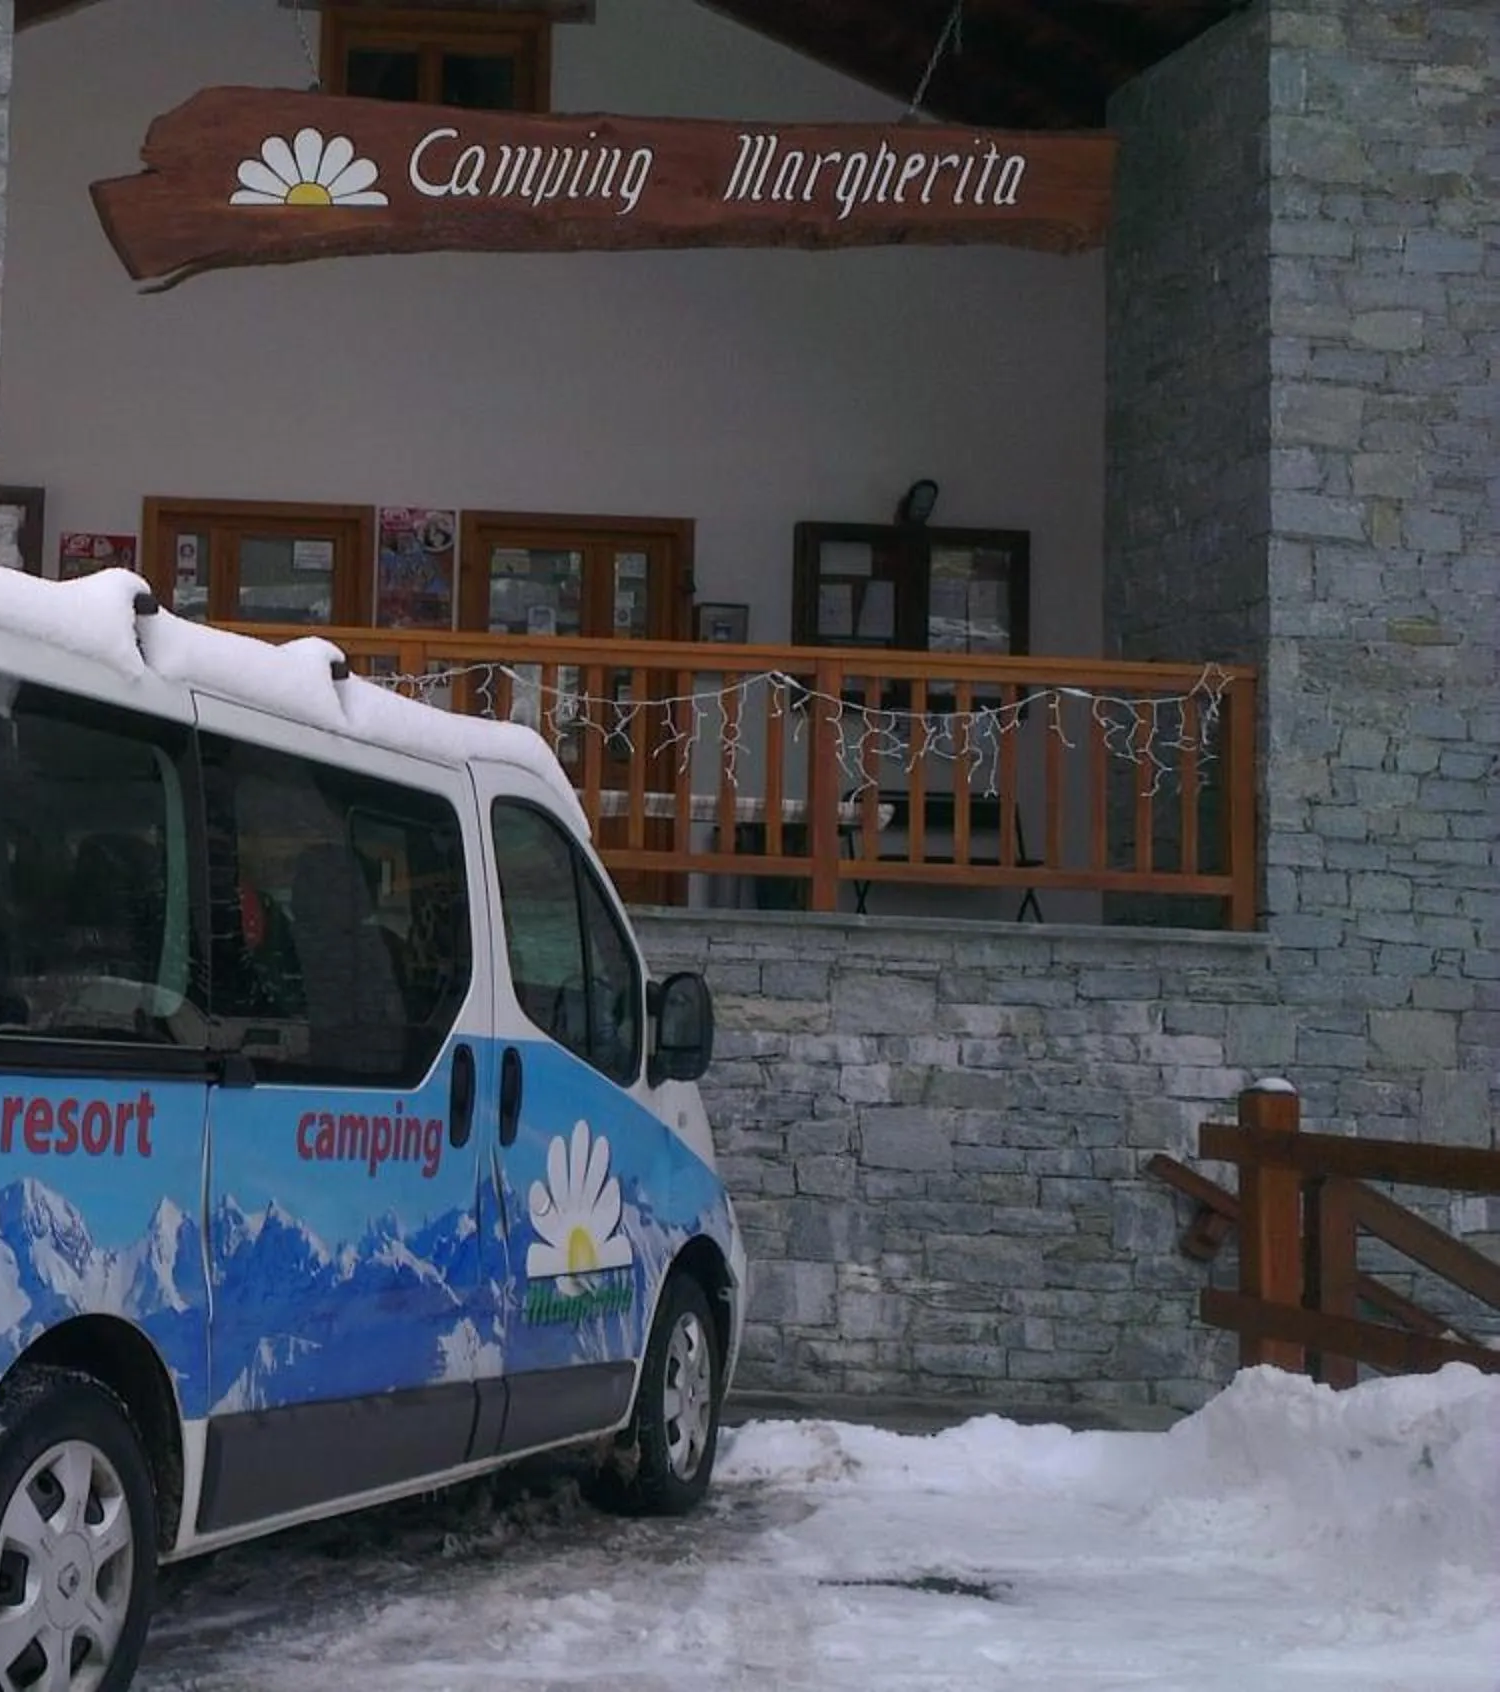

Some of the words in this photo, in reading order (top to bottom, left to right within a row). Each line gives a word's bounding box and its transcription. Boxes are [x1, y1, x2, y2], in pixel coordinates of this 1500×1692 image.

[409, 128, 653, 216] Camping
[723, 134, 1026, 221] Margherita
[0, 1090, 155, 1158] resort
[296, 1101, 443, 1178] camping
